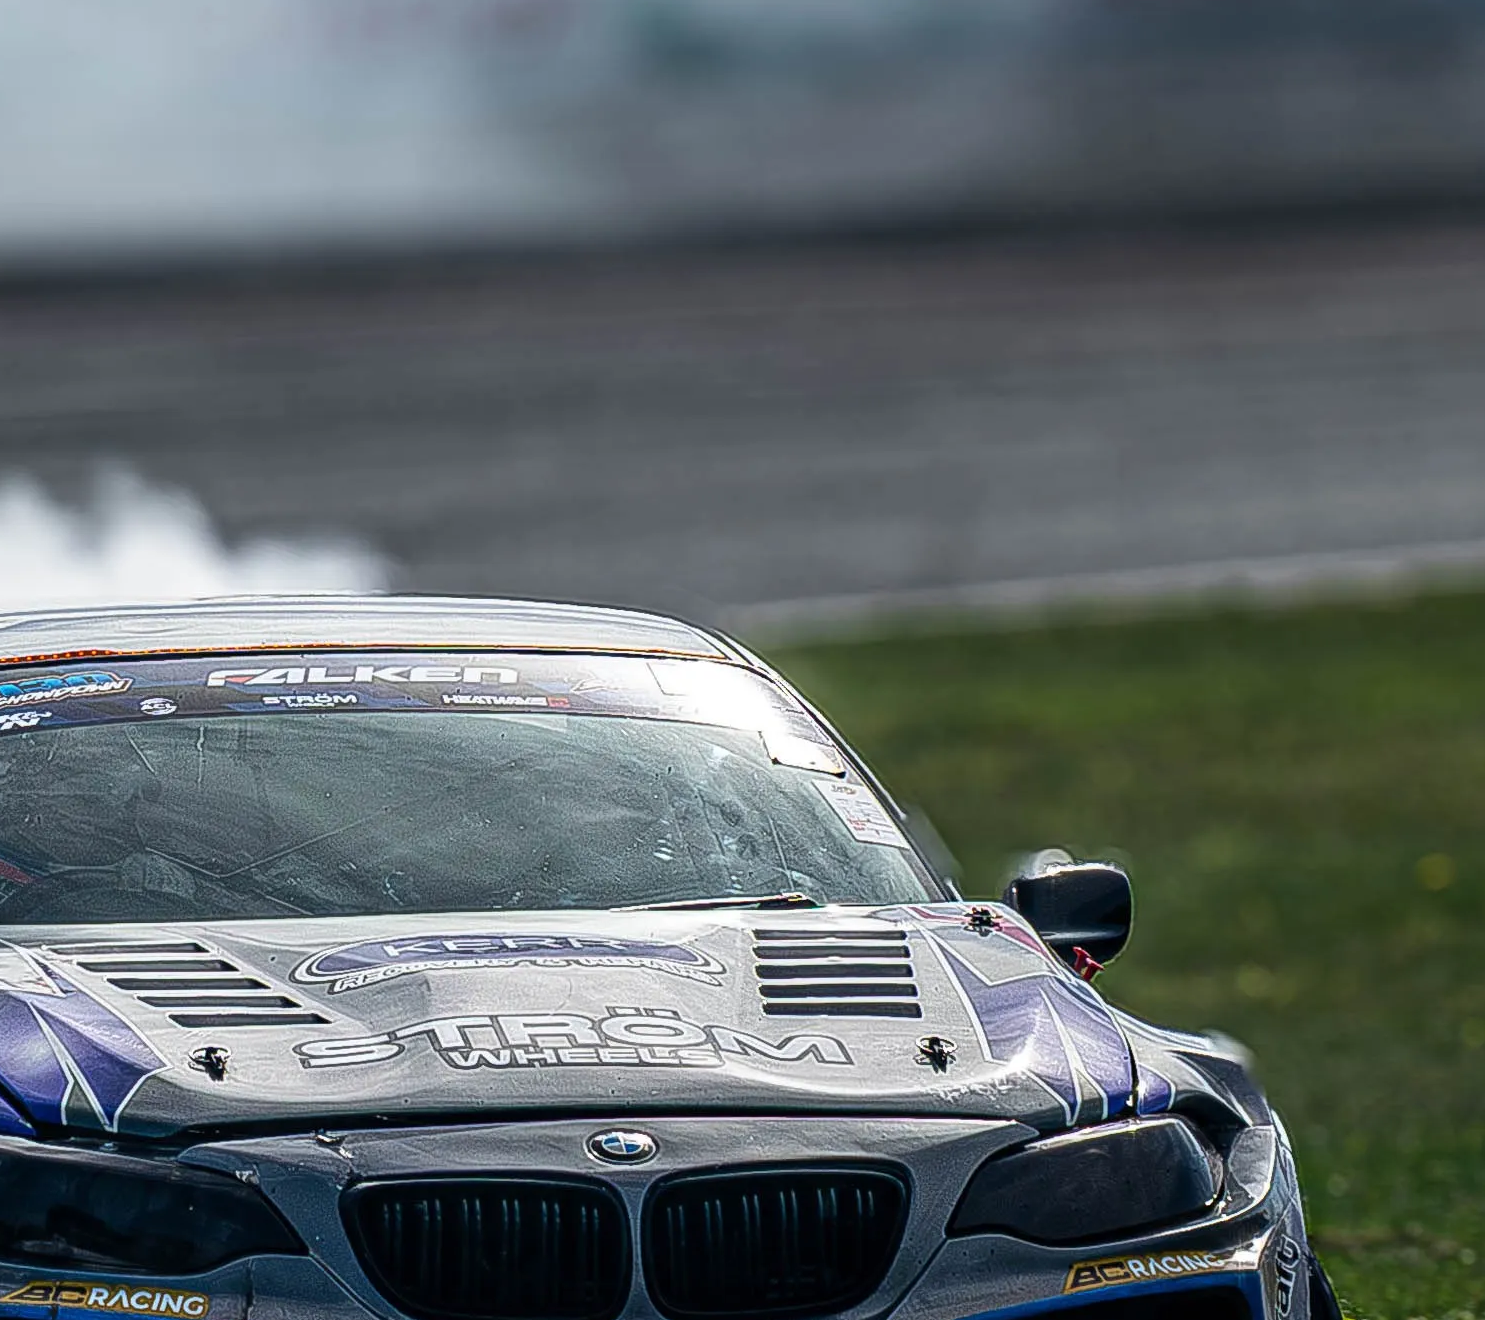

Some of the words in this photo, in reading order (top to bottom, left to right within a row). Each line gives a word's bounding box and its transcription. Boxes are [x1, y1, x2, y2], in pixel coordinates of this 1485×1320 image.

[207, 665, 518, 687] FALKEN
[292, 1005, 855, 1069] STRÖM
[442, 1046, 720, 1068] WHEELS
[1071, 1261, 1132, 1288] BC
[1127, 1253, 1226, 1279] RACING
[11, 1281, 87, 1305] BC
[86, 1287, 205, 1317] RACING
